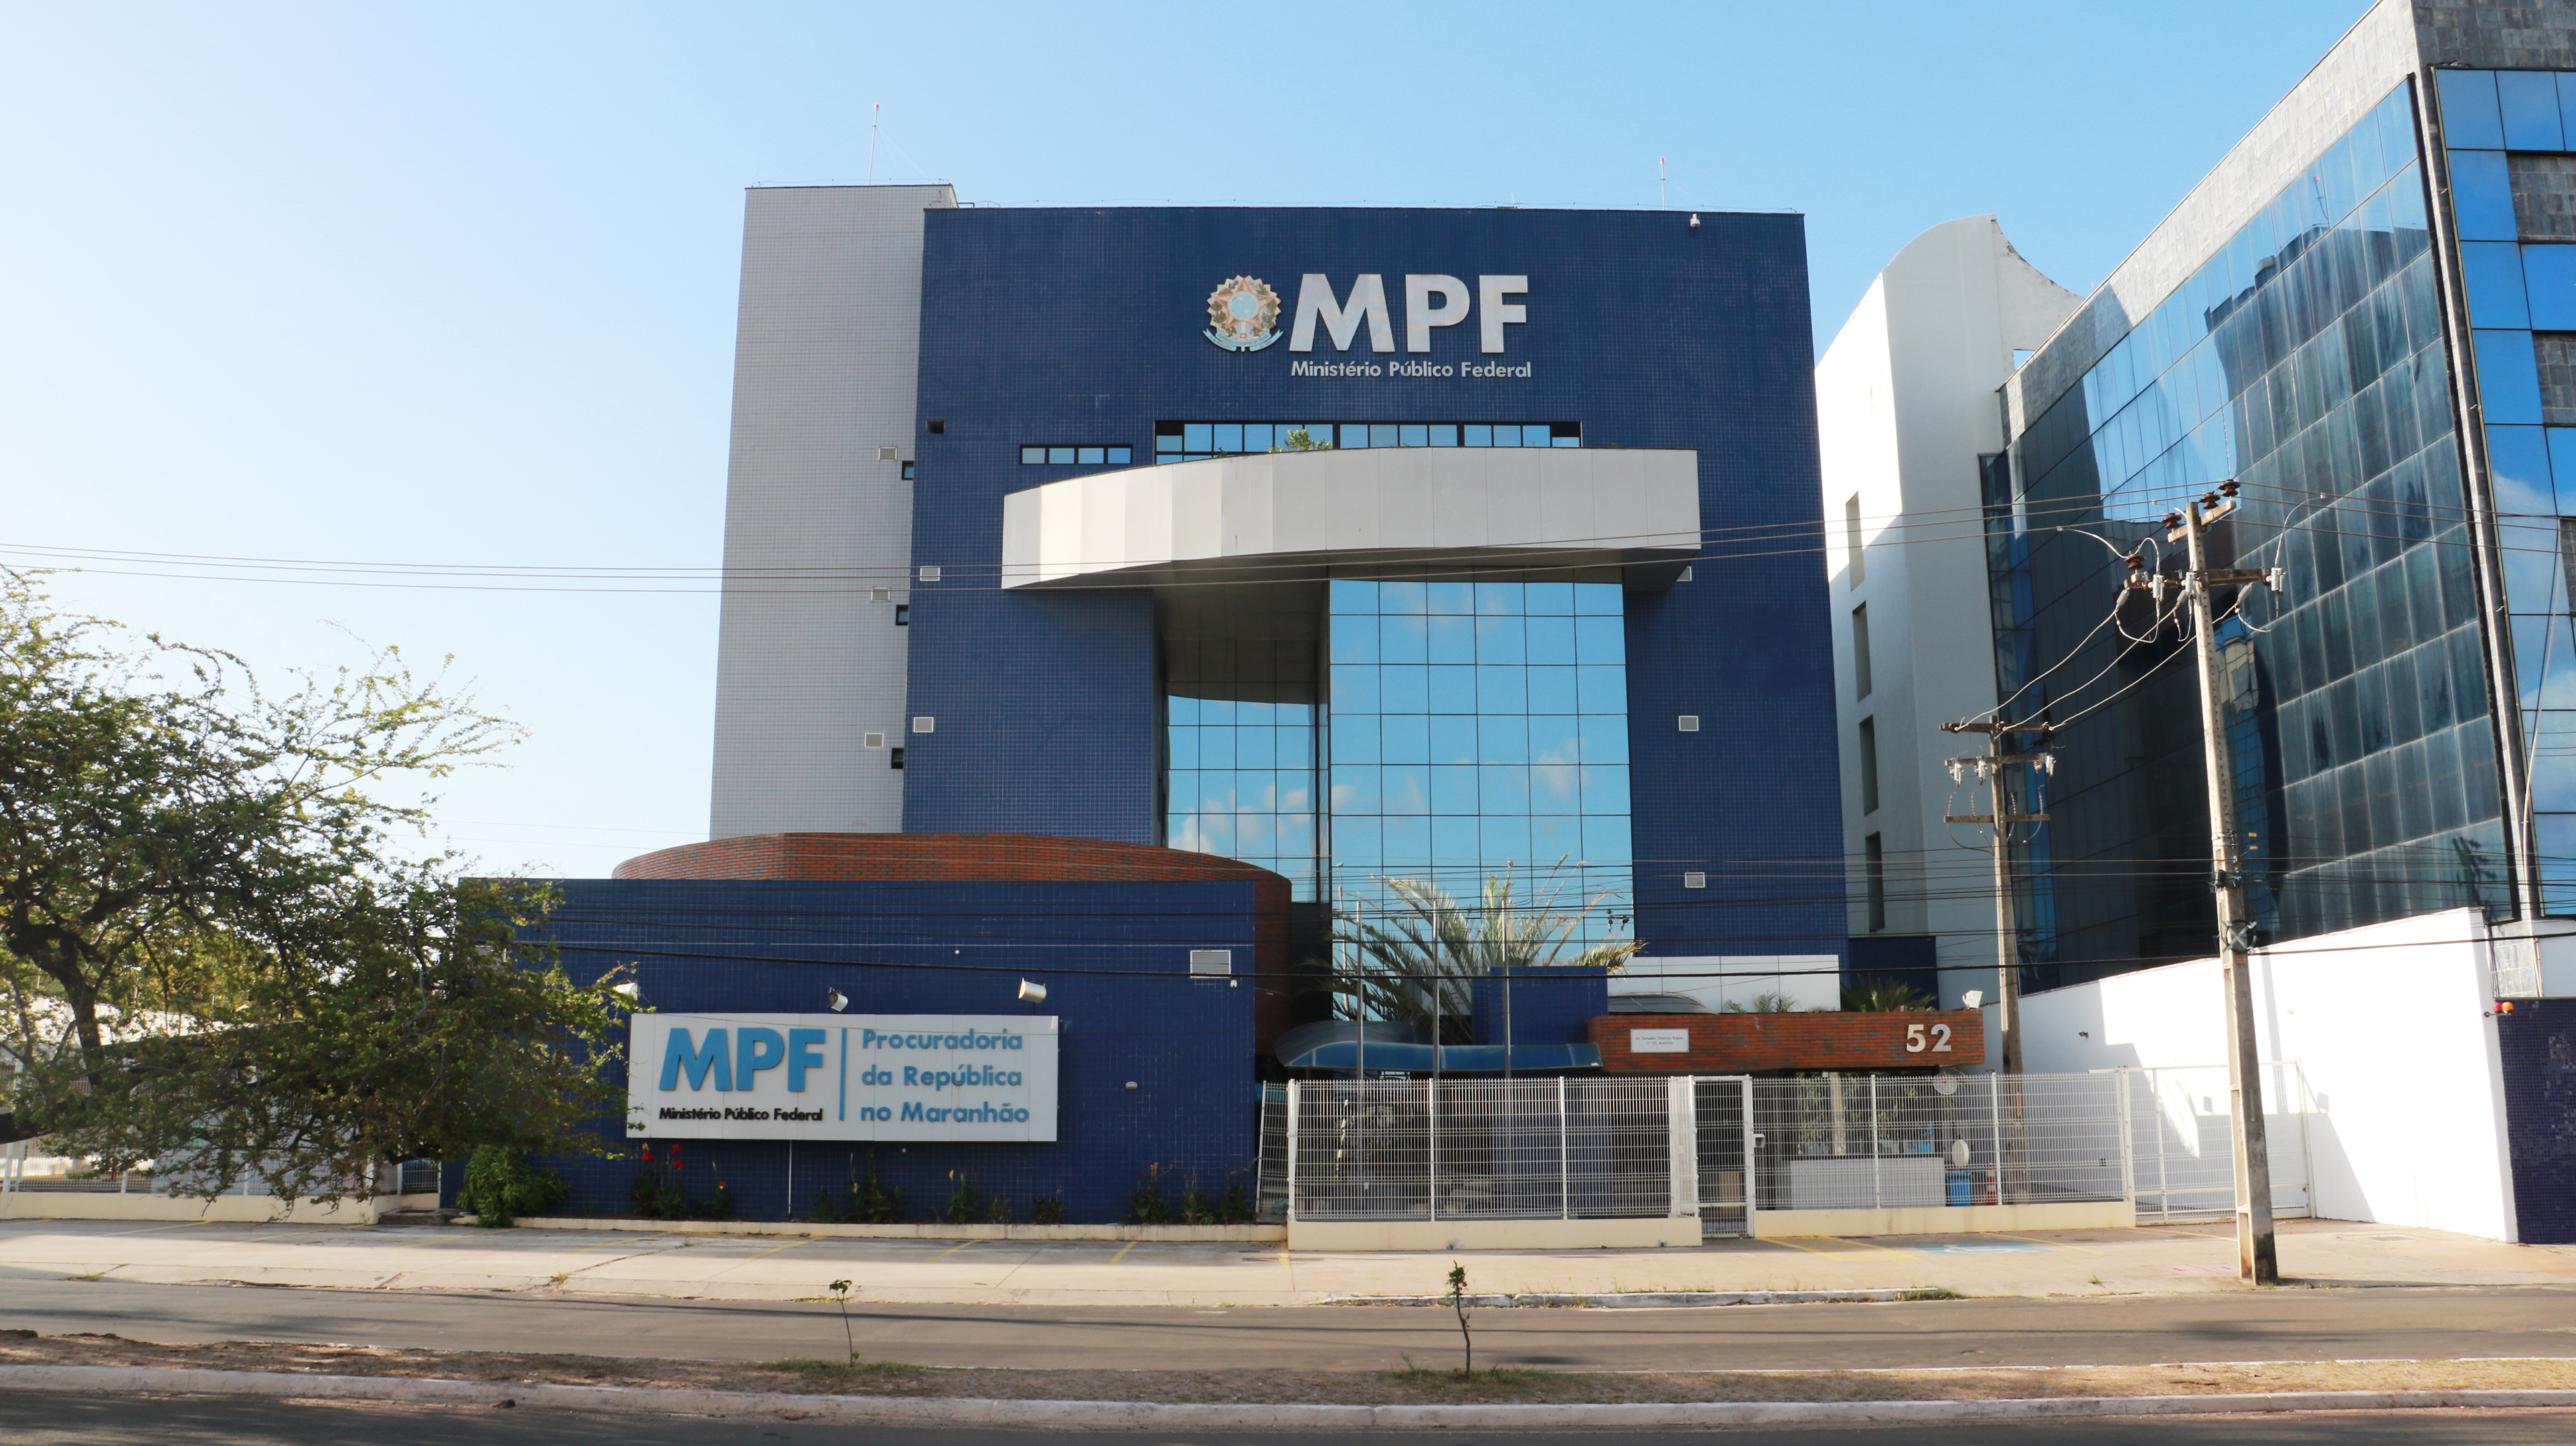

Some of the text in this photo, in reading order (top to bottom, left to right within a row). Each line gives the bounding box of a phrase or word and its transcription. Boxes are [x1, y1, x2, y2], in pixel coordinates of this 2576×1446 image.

[1289, 273, 1528, 353] MPF
[1291, 360, 1531, 378] Ministério Público Federal
[863, 1029, 1023, 1049] Procuradoria
[1906, 1024, 1951, 1052] 52
[659, 1028, 825, 1091] MPF
[862, 1064, 1022, 1091] da República
[659, 1107, 823, 1121] Ministério Público Federal
[861, 1101, 1030, 1122] no Maranhão
